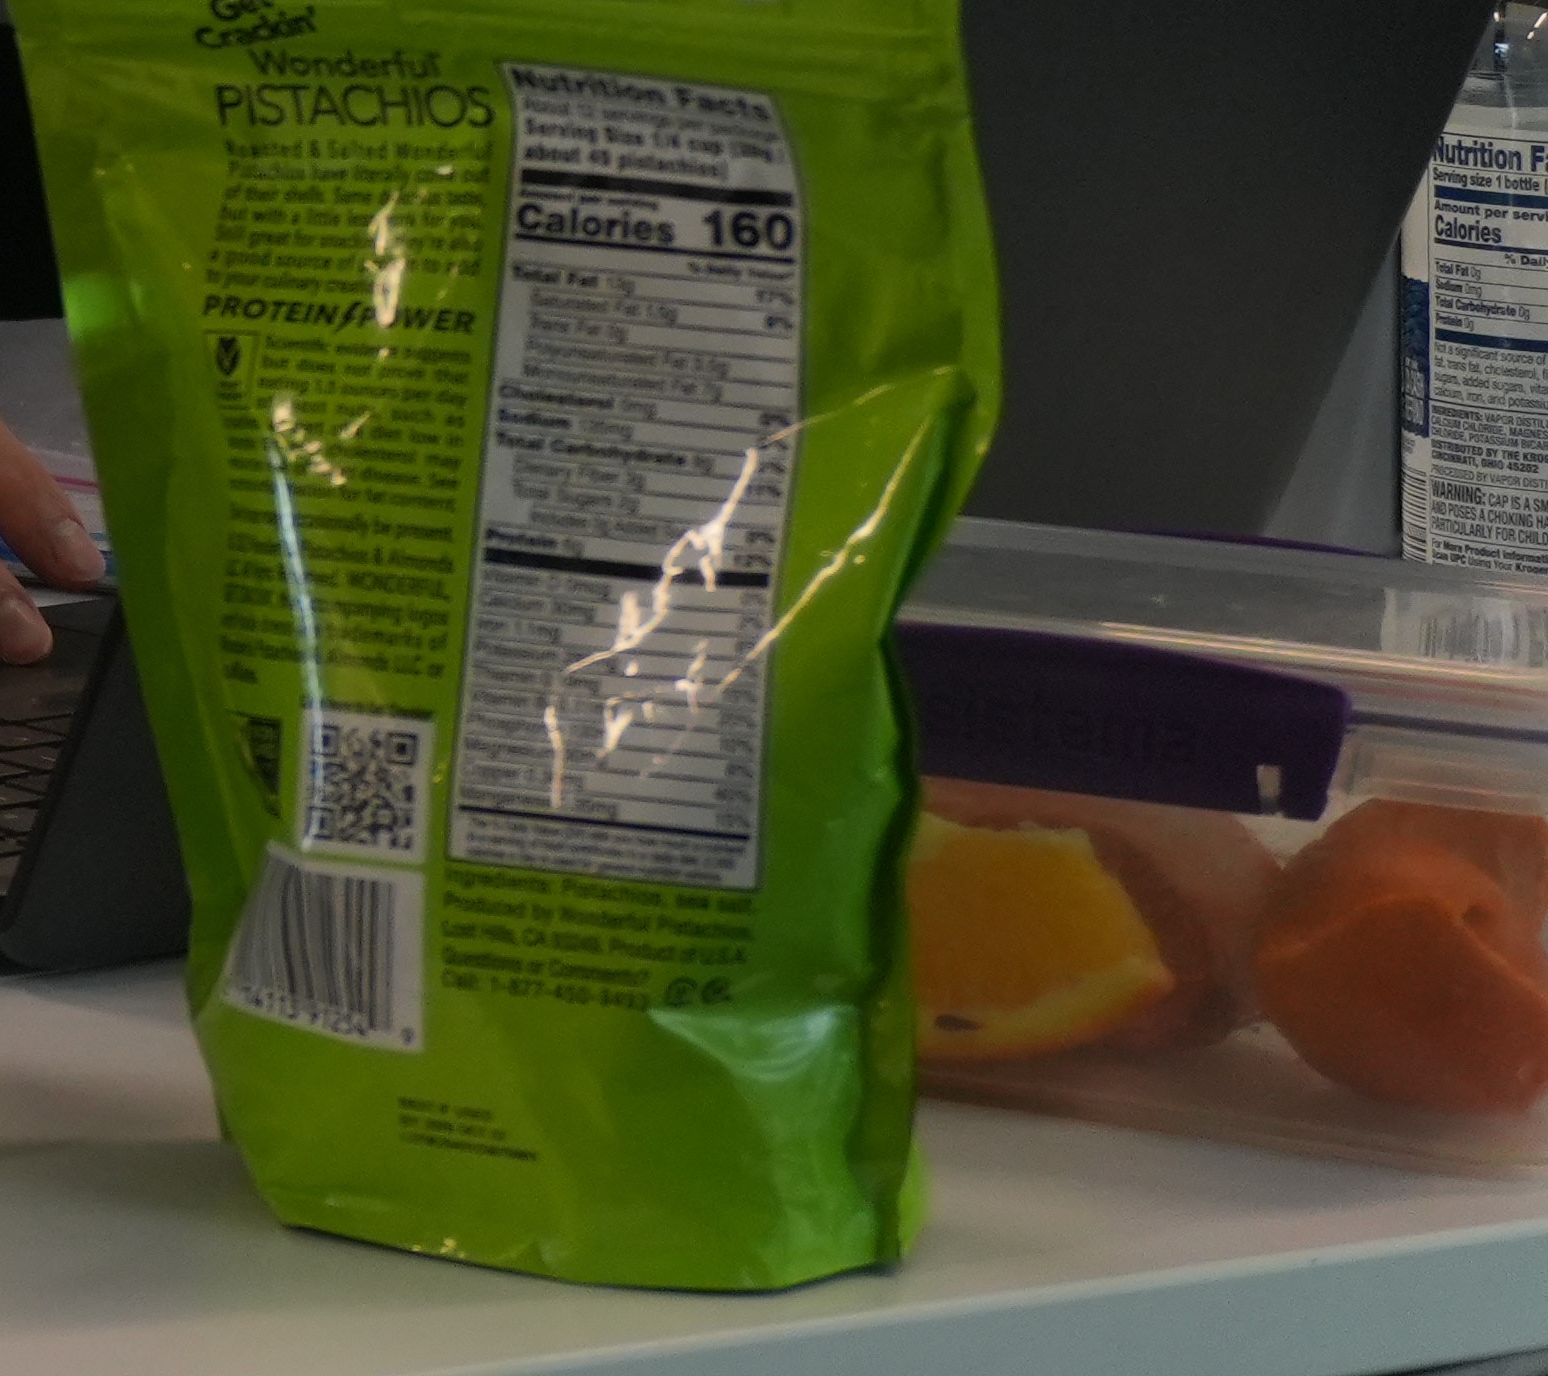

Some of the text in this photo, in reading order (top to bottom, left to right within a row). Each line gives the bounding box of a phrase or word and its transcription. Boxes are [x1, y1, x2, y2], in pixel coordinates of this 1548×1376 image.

[512, 67, 772, 122] Nutrition Facts
[215, 84, 495, 129] PISTACHIOS
[524, 117, 598, 144] Serving
[1433, 135, 1548, 172] Nutrition F
[1433, 167, 1540, 192] Serving size 1 bottle
[1434, 199, 1480, 215] Amount
[1484, 207, 1508, 219] per
[517, 203, 794, 251] Calories 160
[1435, 214, 1502, 244] Calories
[1436, 261, 1453, 274] Total
[1456, 264, 1469, 277] Fat
[1435, 279, 1462, 293] Sodium
[203, 294, 477, 335] PROTEIN PWER
[1436, 296, 1453, 308] Total
[1456, 298, 1516, 317] Carbohydrate
[1436, 313, 1462, 327] Protein
[1455, 346, 1498, 361] significant
[1500, 353, 1534, 364] source
[1536, 354, 1545, 365] of
[1447, 359, 1466, 371] trans
[1484, 363, 1539, 381] cholesterol,
[1462, 375, 1489, 389] added
[1487, 394, 1505, 405] and
[1484, 413, 1514, 425] VAPOR
[1431, 439, 1483, 456] DISTRIBUTED
[1486, 448, 1498, 458] BY
[1502, 449, 1520, 460] THE
[1469, 433, 1518, 448] POTASSIUM
[1481, 458, 1504, 470] OHIO
[1507, 461, 1539, 473] 45202
[1476, 471, 1487, 482] BY
[1489, 473, 1520, 487] VAPOR
[1431, 479, 1486, 505] WARNING:
[1488, 493, 1509, 508] CAP
[1511, 496, 1521, 510] IS
[1524, 497, 1530, 511] A
[1432, 500, 1446, 515] AND
[1448, 503, 1476, 521] POSES
[1479, 508, 1486, 521] A
[1488, 509, 1533, 528] CHOKING
[1431, 516, 1492, 539] PARTICULARLY
[1495, 527, 1516, 541] FOR
[1443, 540, 1462, 553] More
[1464, 545, 1500, 558] Product
[1450, 554, 1466, 564] UPC
[1468, 557, 1491, 569] Using
[1493, 561, 1513, 571] Your
